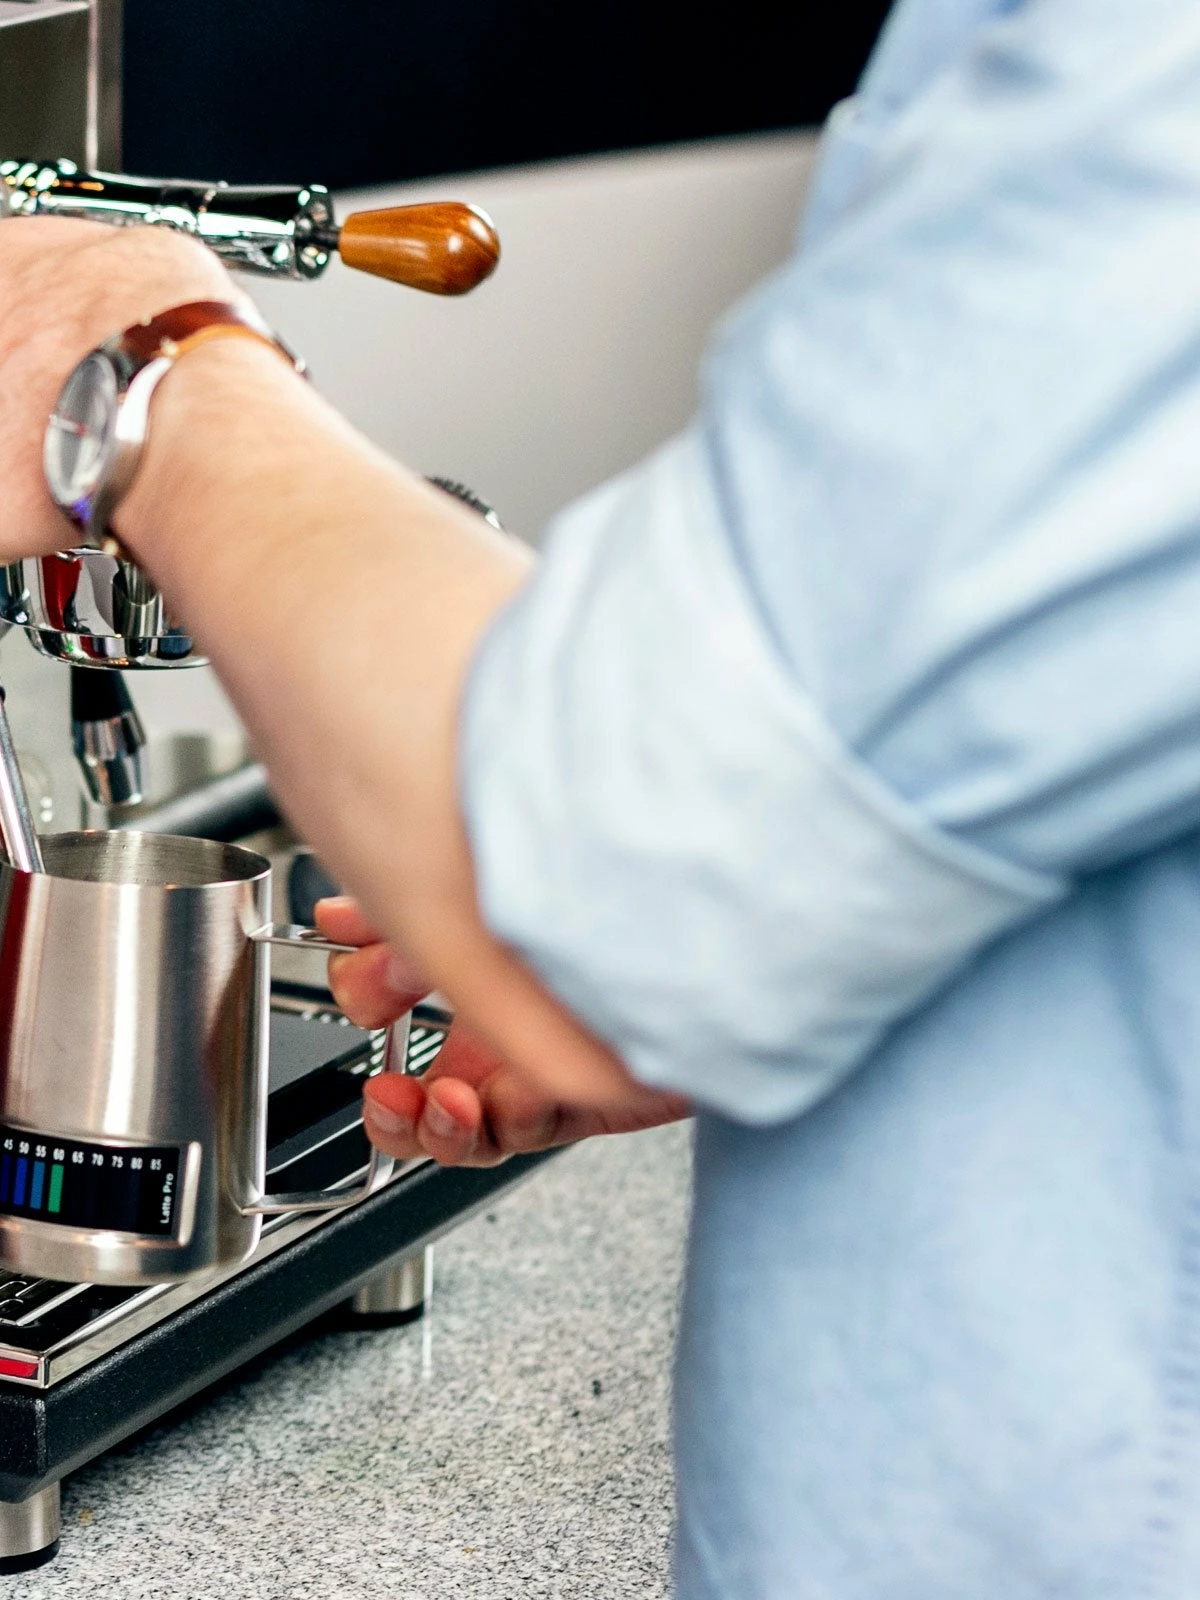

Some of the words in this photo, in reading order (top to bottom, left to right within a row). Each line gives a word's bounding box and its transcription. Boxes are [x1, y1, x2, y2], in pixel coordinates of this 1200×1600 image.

[3, 1139, 13, 1150] 45
[19, 1141, 30, 1154] 50
[35, 1144, 47, 1158] 55
[53, 1148, 65, 1161] 60
[72, 1151, 84, 1164] 65
[92, 1152, 104, 1166] 70
[112, 1155, 123, 1168] 75
[130, 1157, 143, 1170] 80
[150, 1159, 162, 1170] 85
[162, 1173, 174, 1193] Pro
[160, 1195, 171, 1223] Latte
